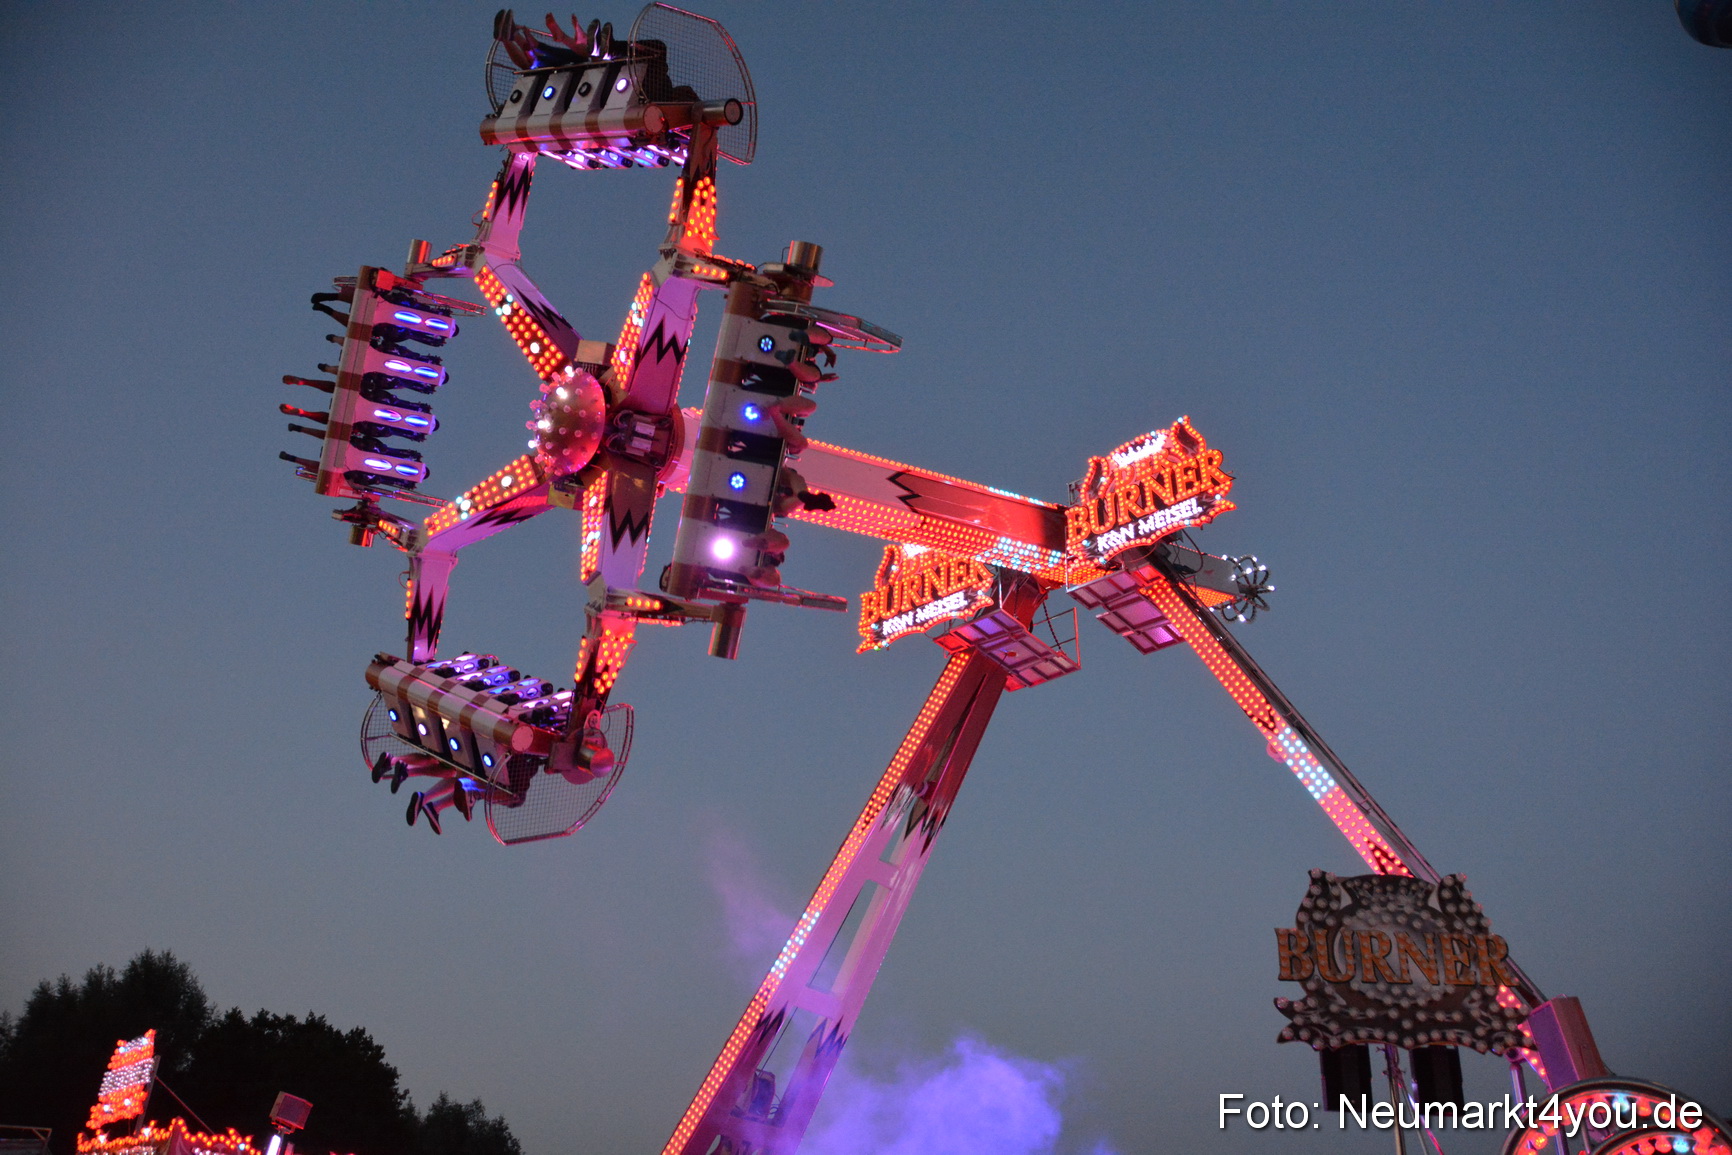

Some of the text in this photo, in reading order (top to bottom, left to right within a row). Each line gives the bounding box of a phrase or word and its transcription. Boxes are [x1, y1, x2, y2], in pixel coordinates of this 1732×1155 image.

[1066, 449, 1236, 545] BURNER
[859, 555, 995, 627] BURNER
[1274, 927, 1520, 987] BURNER
